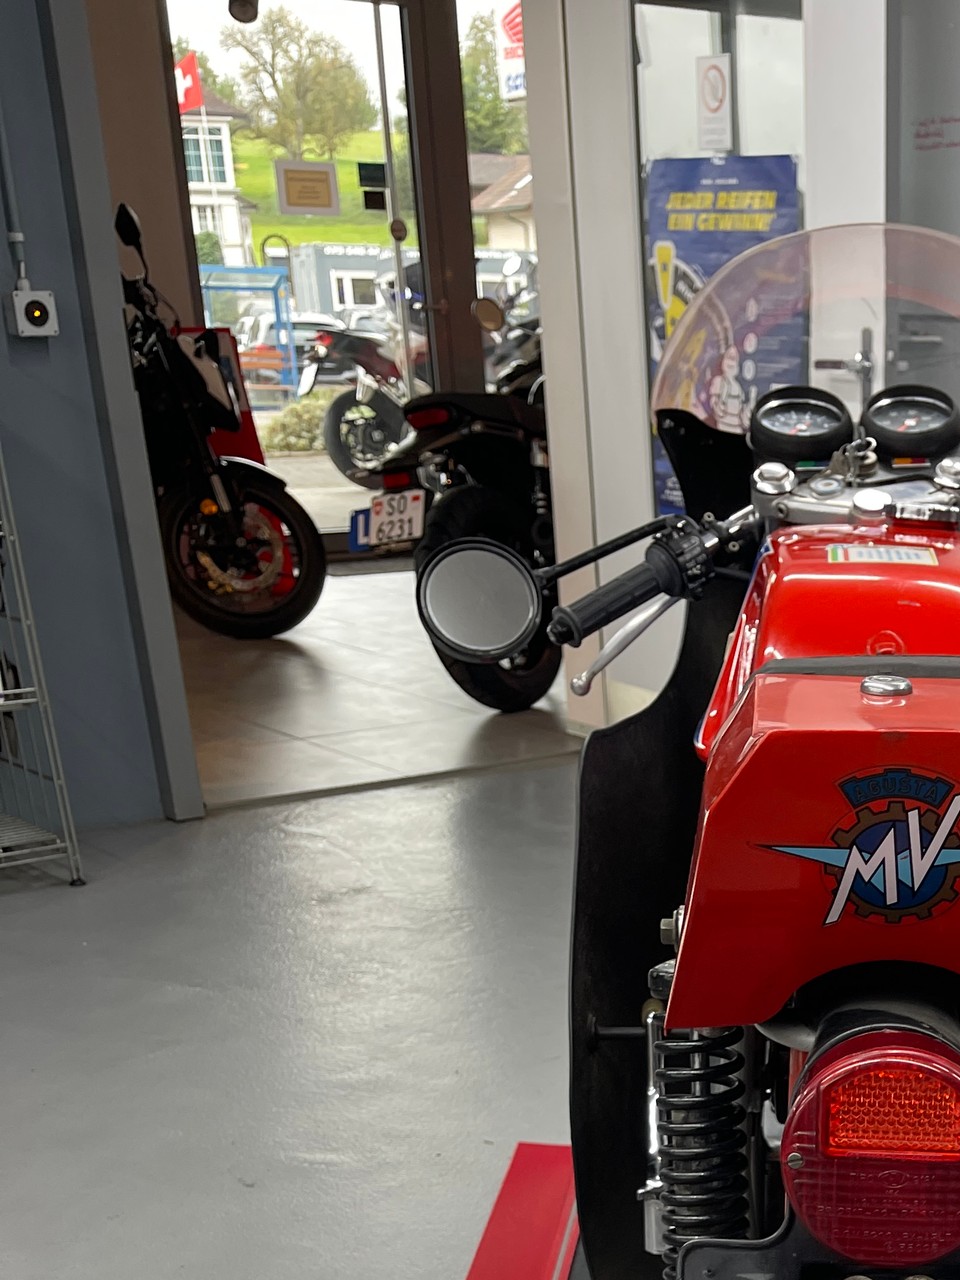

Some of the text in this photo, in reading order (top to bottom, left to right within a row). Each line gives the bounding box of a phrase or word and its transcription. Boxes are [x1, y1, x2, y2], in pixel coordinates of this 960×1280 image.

[665, 190, 777, 210] JEDER REIFEN
[667, 212, 695, 231] EIN
[386, 494, 408, 516] SO
[376, 517, 413, 541] 6231
[854, 776, 940, 801] AGUSTA
